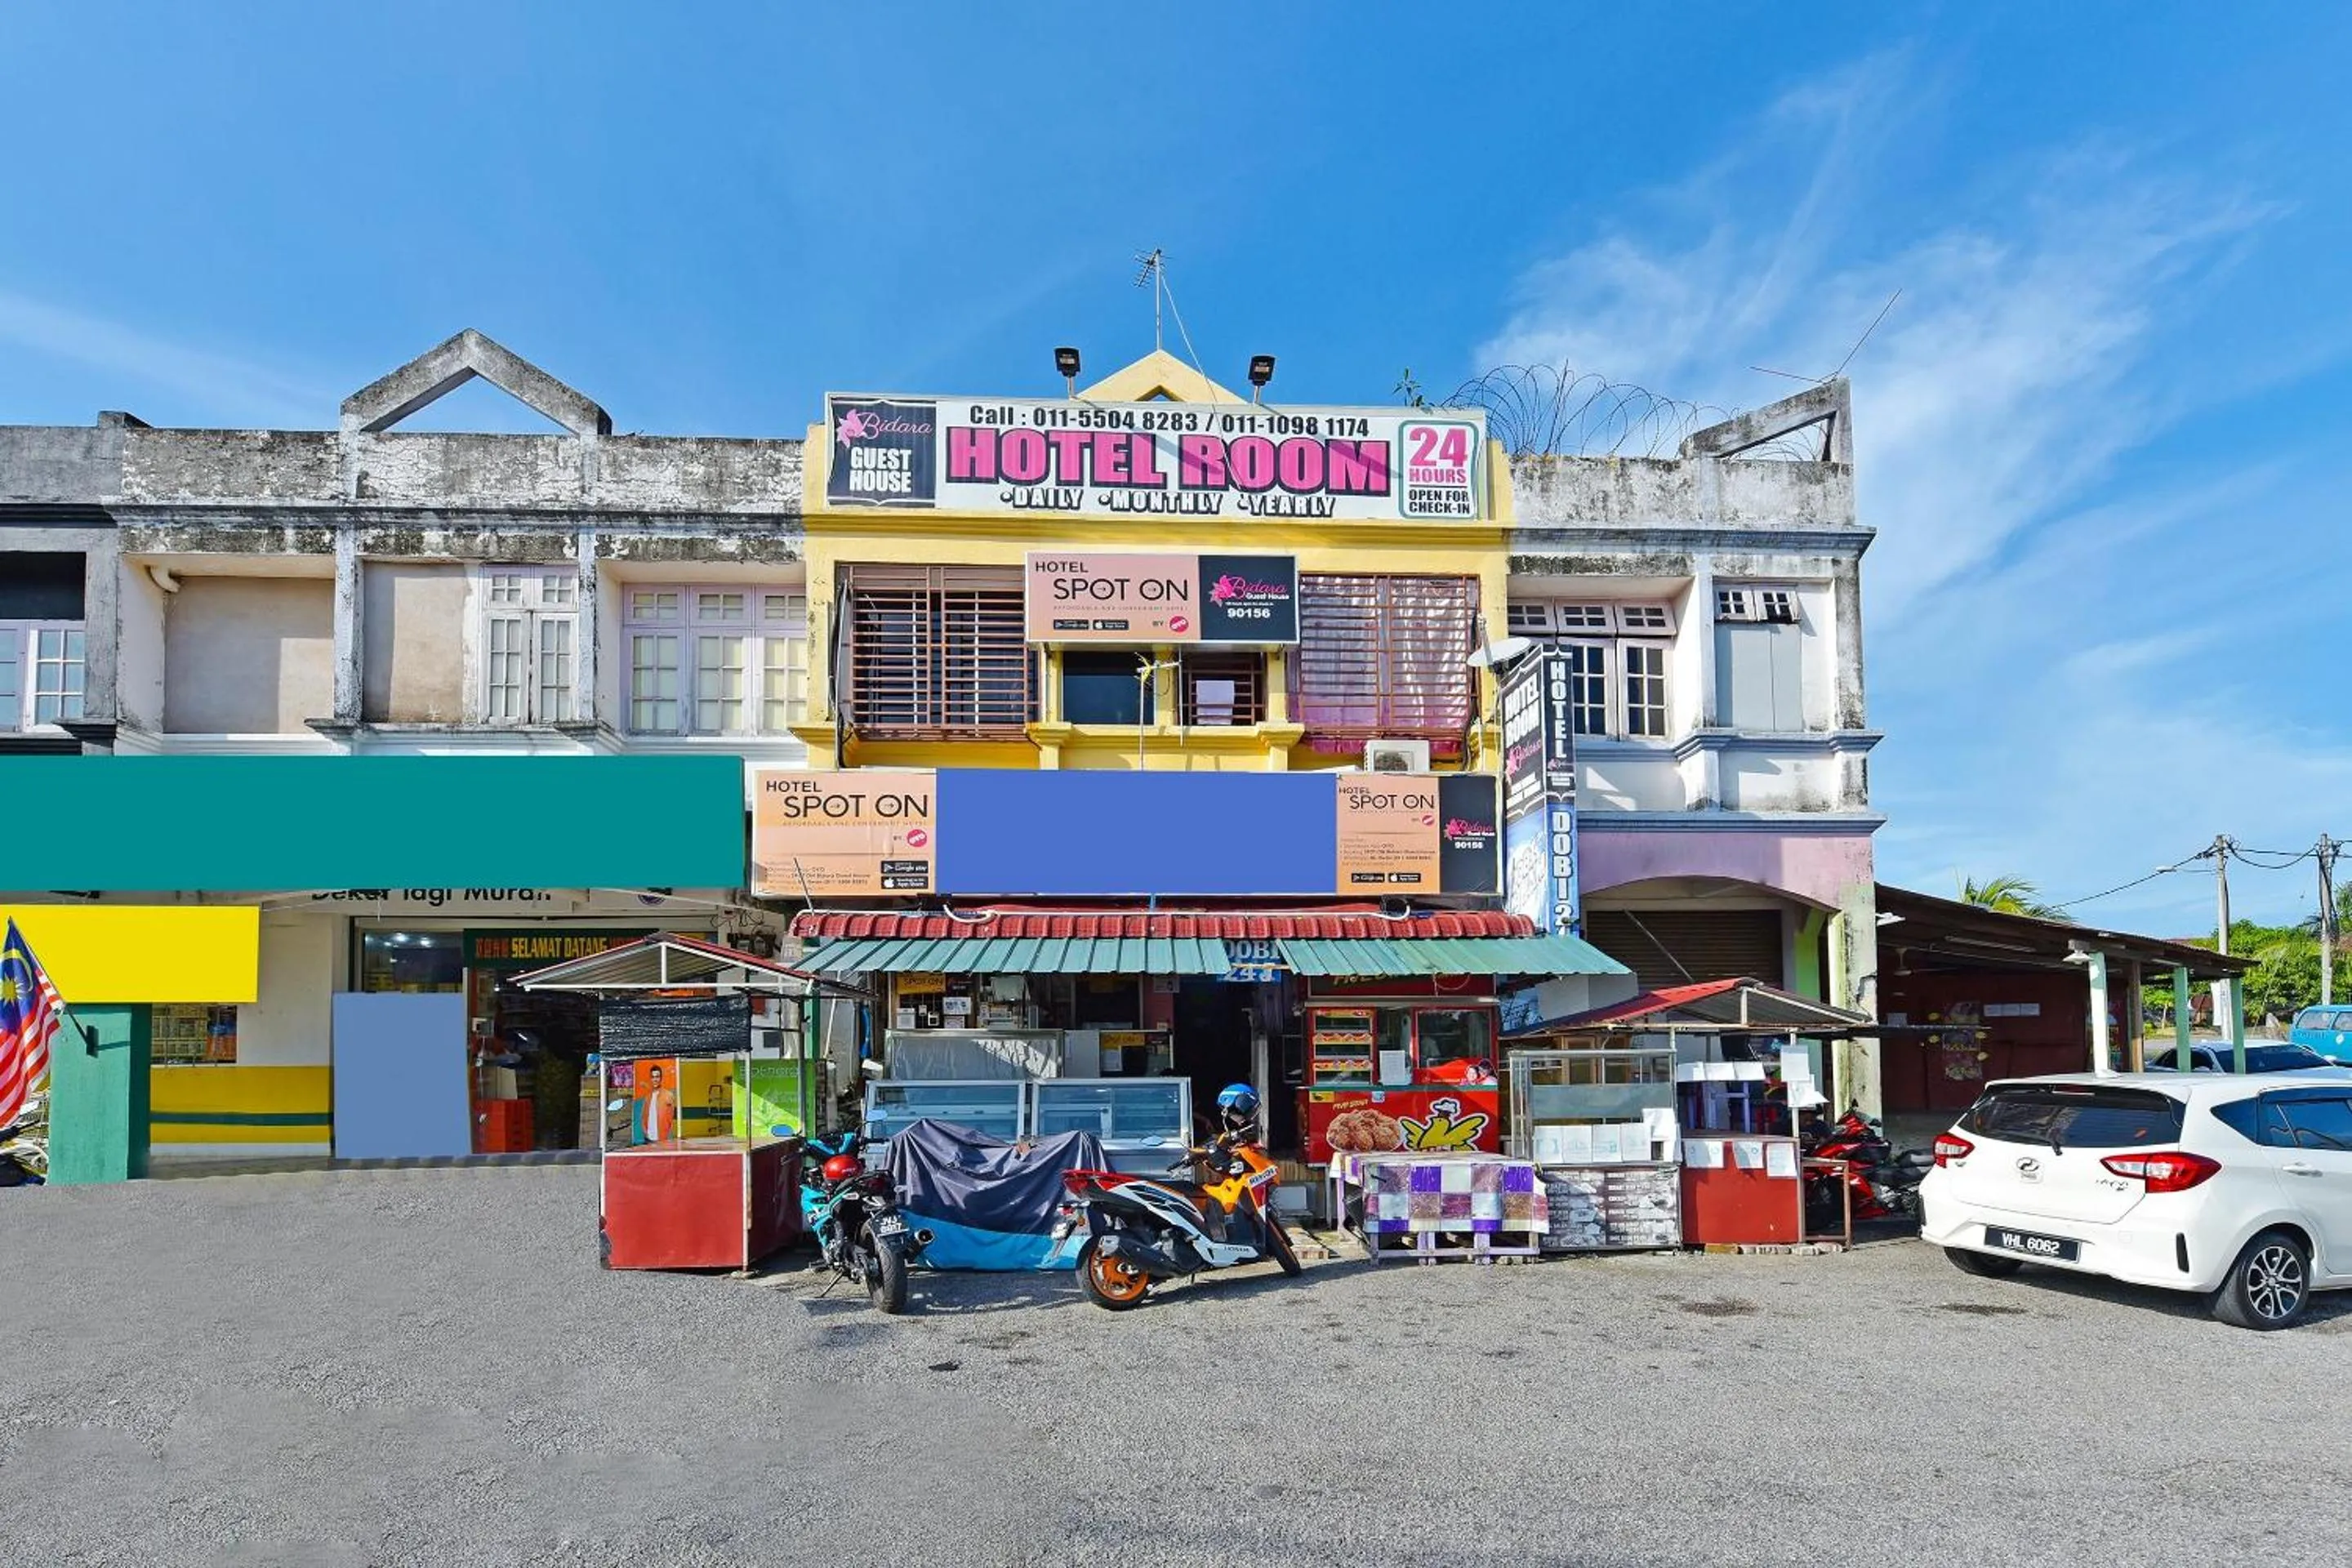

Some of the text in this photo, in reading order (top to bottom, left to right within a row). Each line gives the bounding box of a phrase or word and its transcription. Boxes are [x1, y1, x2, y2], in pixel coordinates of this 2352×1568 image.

[858, 412, 933, 439] Bidara
[970, 406, 1013, 425] Call
[1033, 408, 1134, 429] 011-5504
[1143, 411, 1197, 431] 8283
[1223, 415, 1318, 435] 011-1098
[1325, 418, 1370, 437] 1174
[850, 447, 912, 470] GUEST
[1409, 427, 1468, 468] 24
[947, 426, 1390, 497] HOTEL ROOM
[849, 470, 912, 492] HOUSE
[1409, 468, 1467, 484] HOURS
[1409, 490, 1469, 503] OPEN FOR
[1409, 501, 1470, 514] CHECK-IN
[1036, 561, 1089, 573] HOTEL
[1054, 578, 1188, 601] SPOT ON
[1228, 577, 1287, 599] Bidara
[1227, 608, 1271, 618] 90156
[1550, 661, 1567, 759] HOTEL
[766, 781, 822, 792] HOTEL
[784, 795, 928, 817] SPOT ON
[1350, 795, 1435, 809] SPOT ON
[511, 938, 562, 957] SELAMAT
[2002, 1232, 2025, 1248] VHL
[2027, 1237, 2060, 1254] 6062
